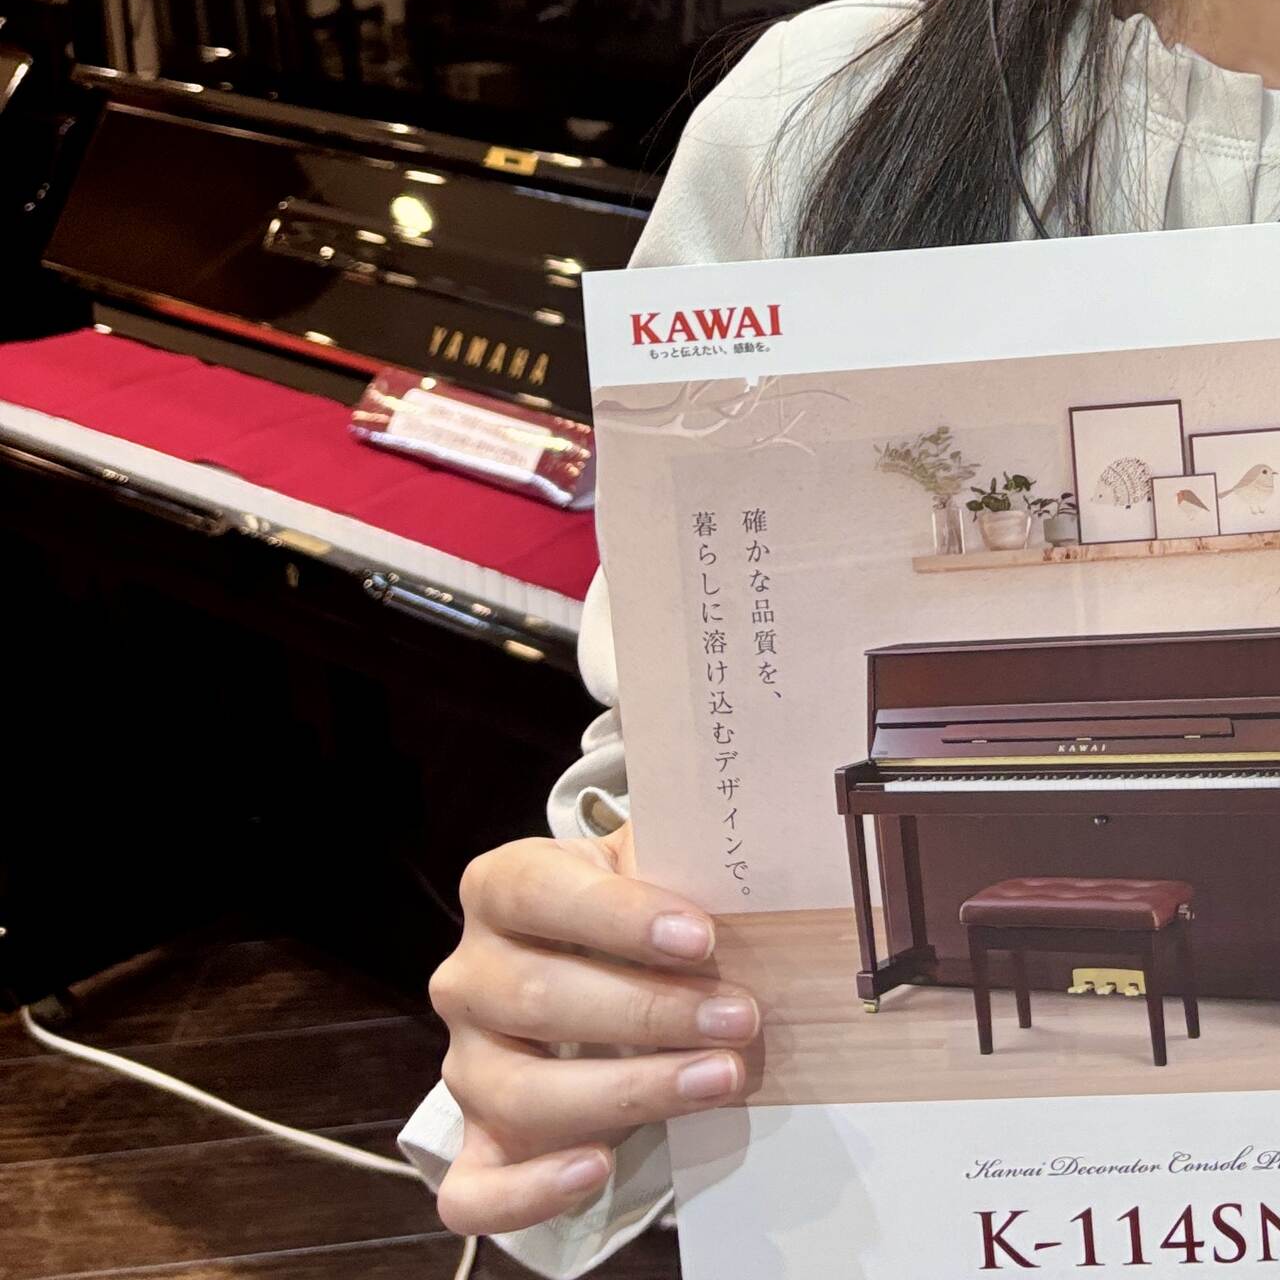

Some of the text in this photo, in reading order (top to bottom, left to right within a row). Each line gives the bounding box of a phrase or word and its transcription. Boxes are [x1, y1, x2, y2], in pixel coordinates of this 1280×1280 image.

[629, 304, 784, 346] KAWAI
[428, 325, 550, 386] YAMAHA
[741, 508, 782, 699] 確かな品質を、
[692, 511, 750, 896] 暮らしに溶け込むデザインで。
[1058, 744, 1106, 752] KAWAI
[965, 1158, 1046, 1179] Kawai
[1048, 1156, 1160, 1177] Decorator
[1168, 1145, 1254, 1175] Console
